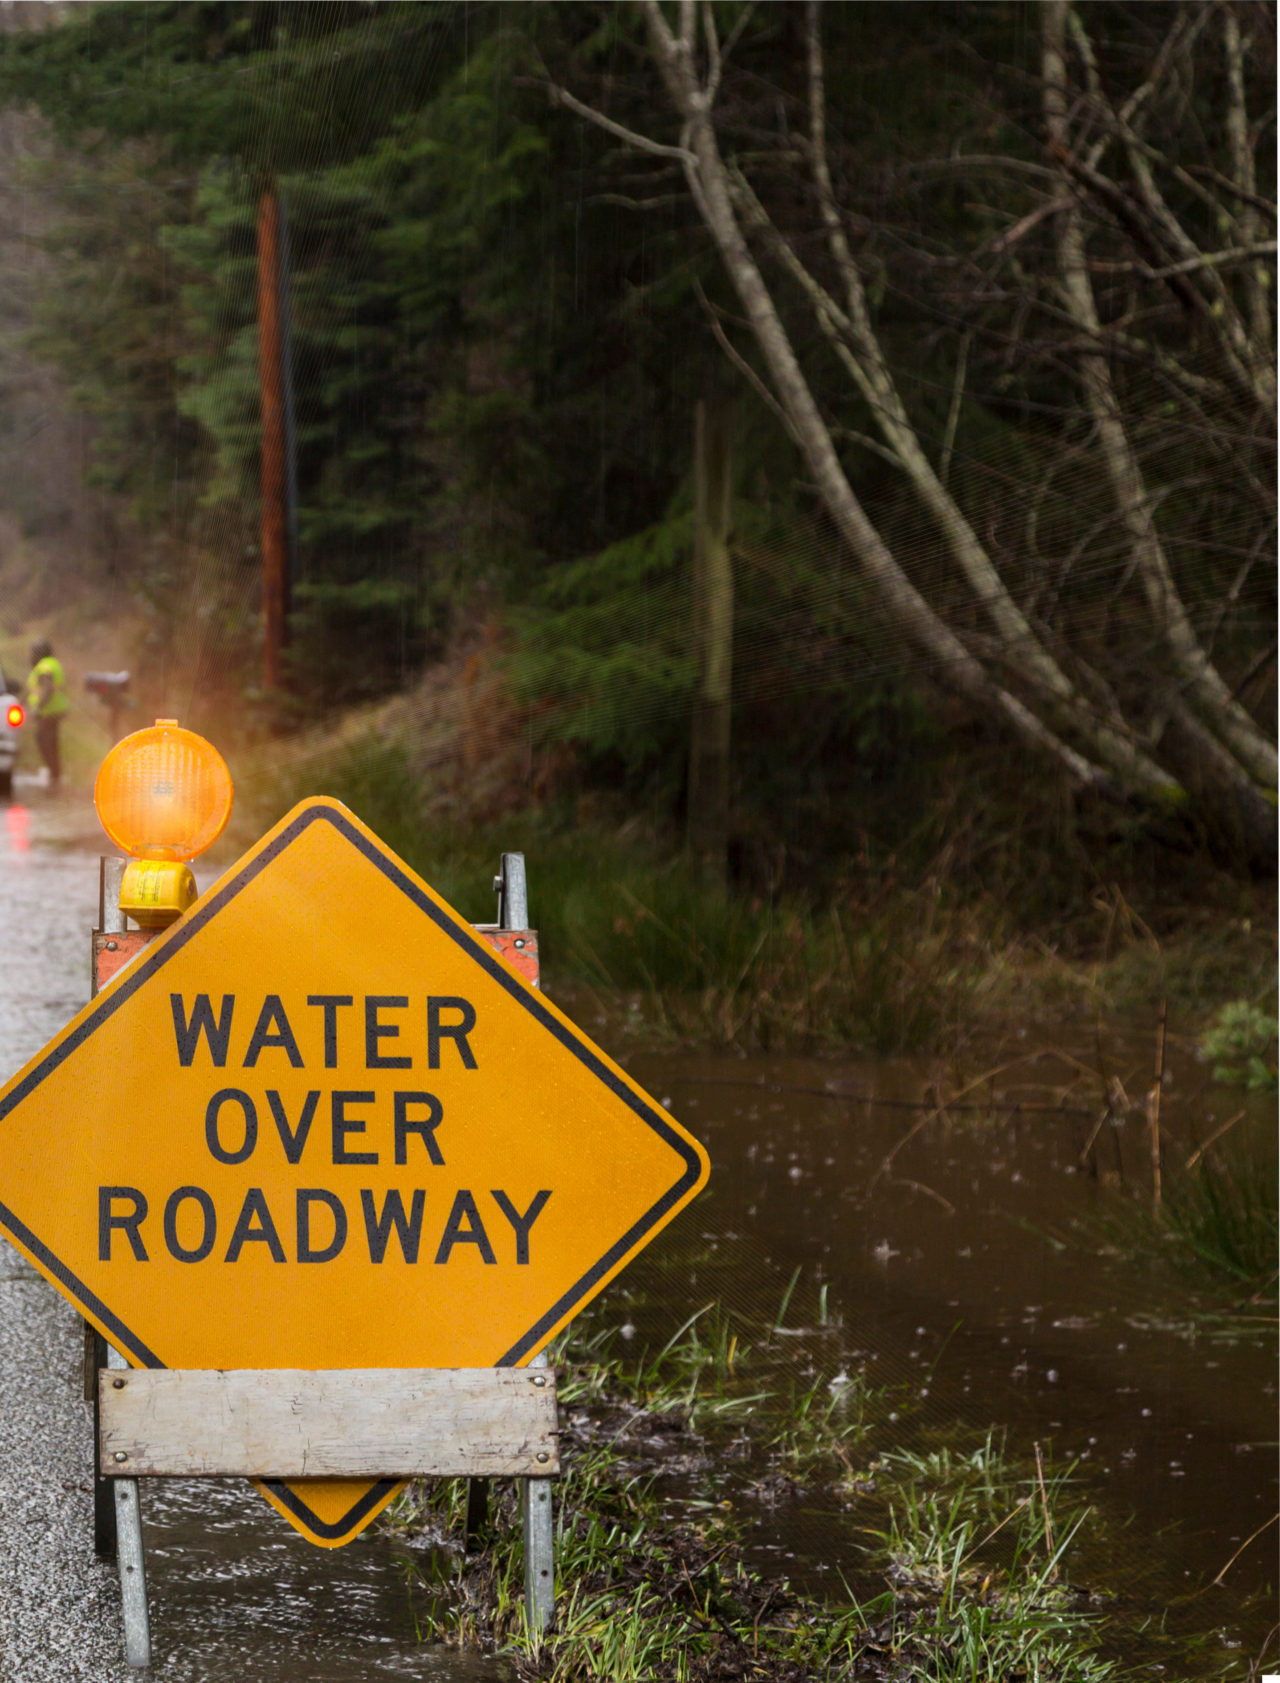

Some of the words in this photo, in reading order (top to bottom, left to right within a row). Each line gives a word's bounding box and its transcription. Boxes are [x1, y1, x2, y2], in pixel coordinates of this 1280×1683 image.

[170, 993, 479, 1070] WATER
[205, 1088, 446, 1166] OVER
[98, 1186, 553, 1265] ROADWAY
